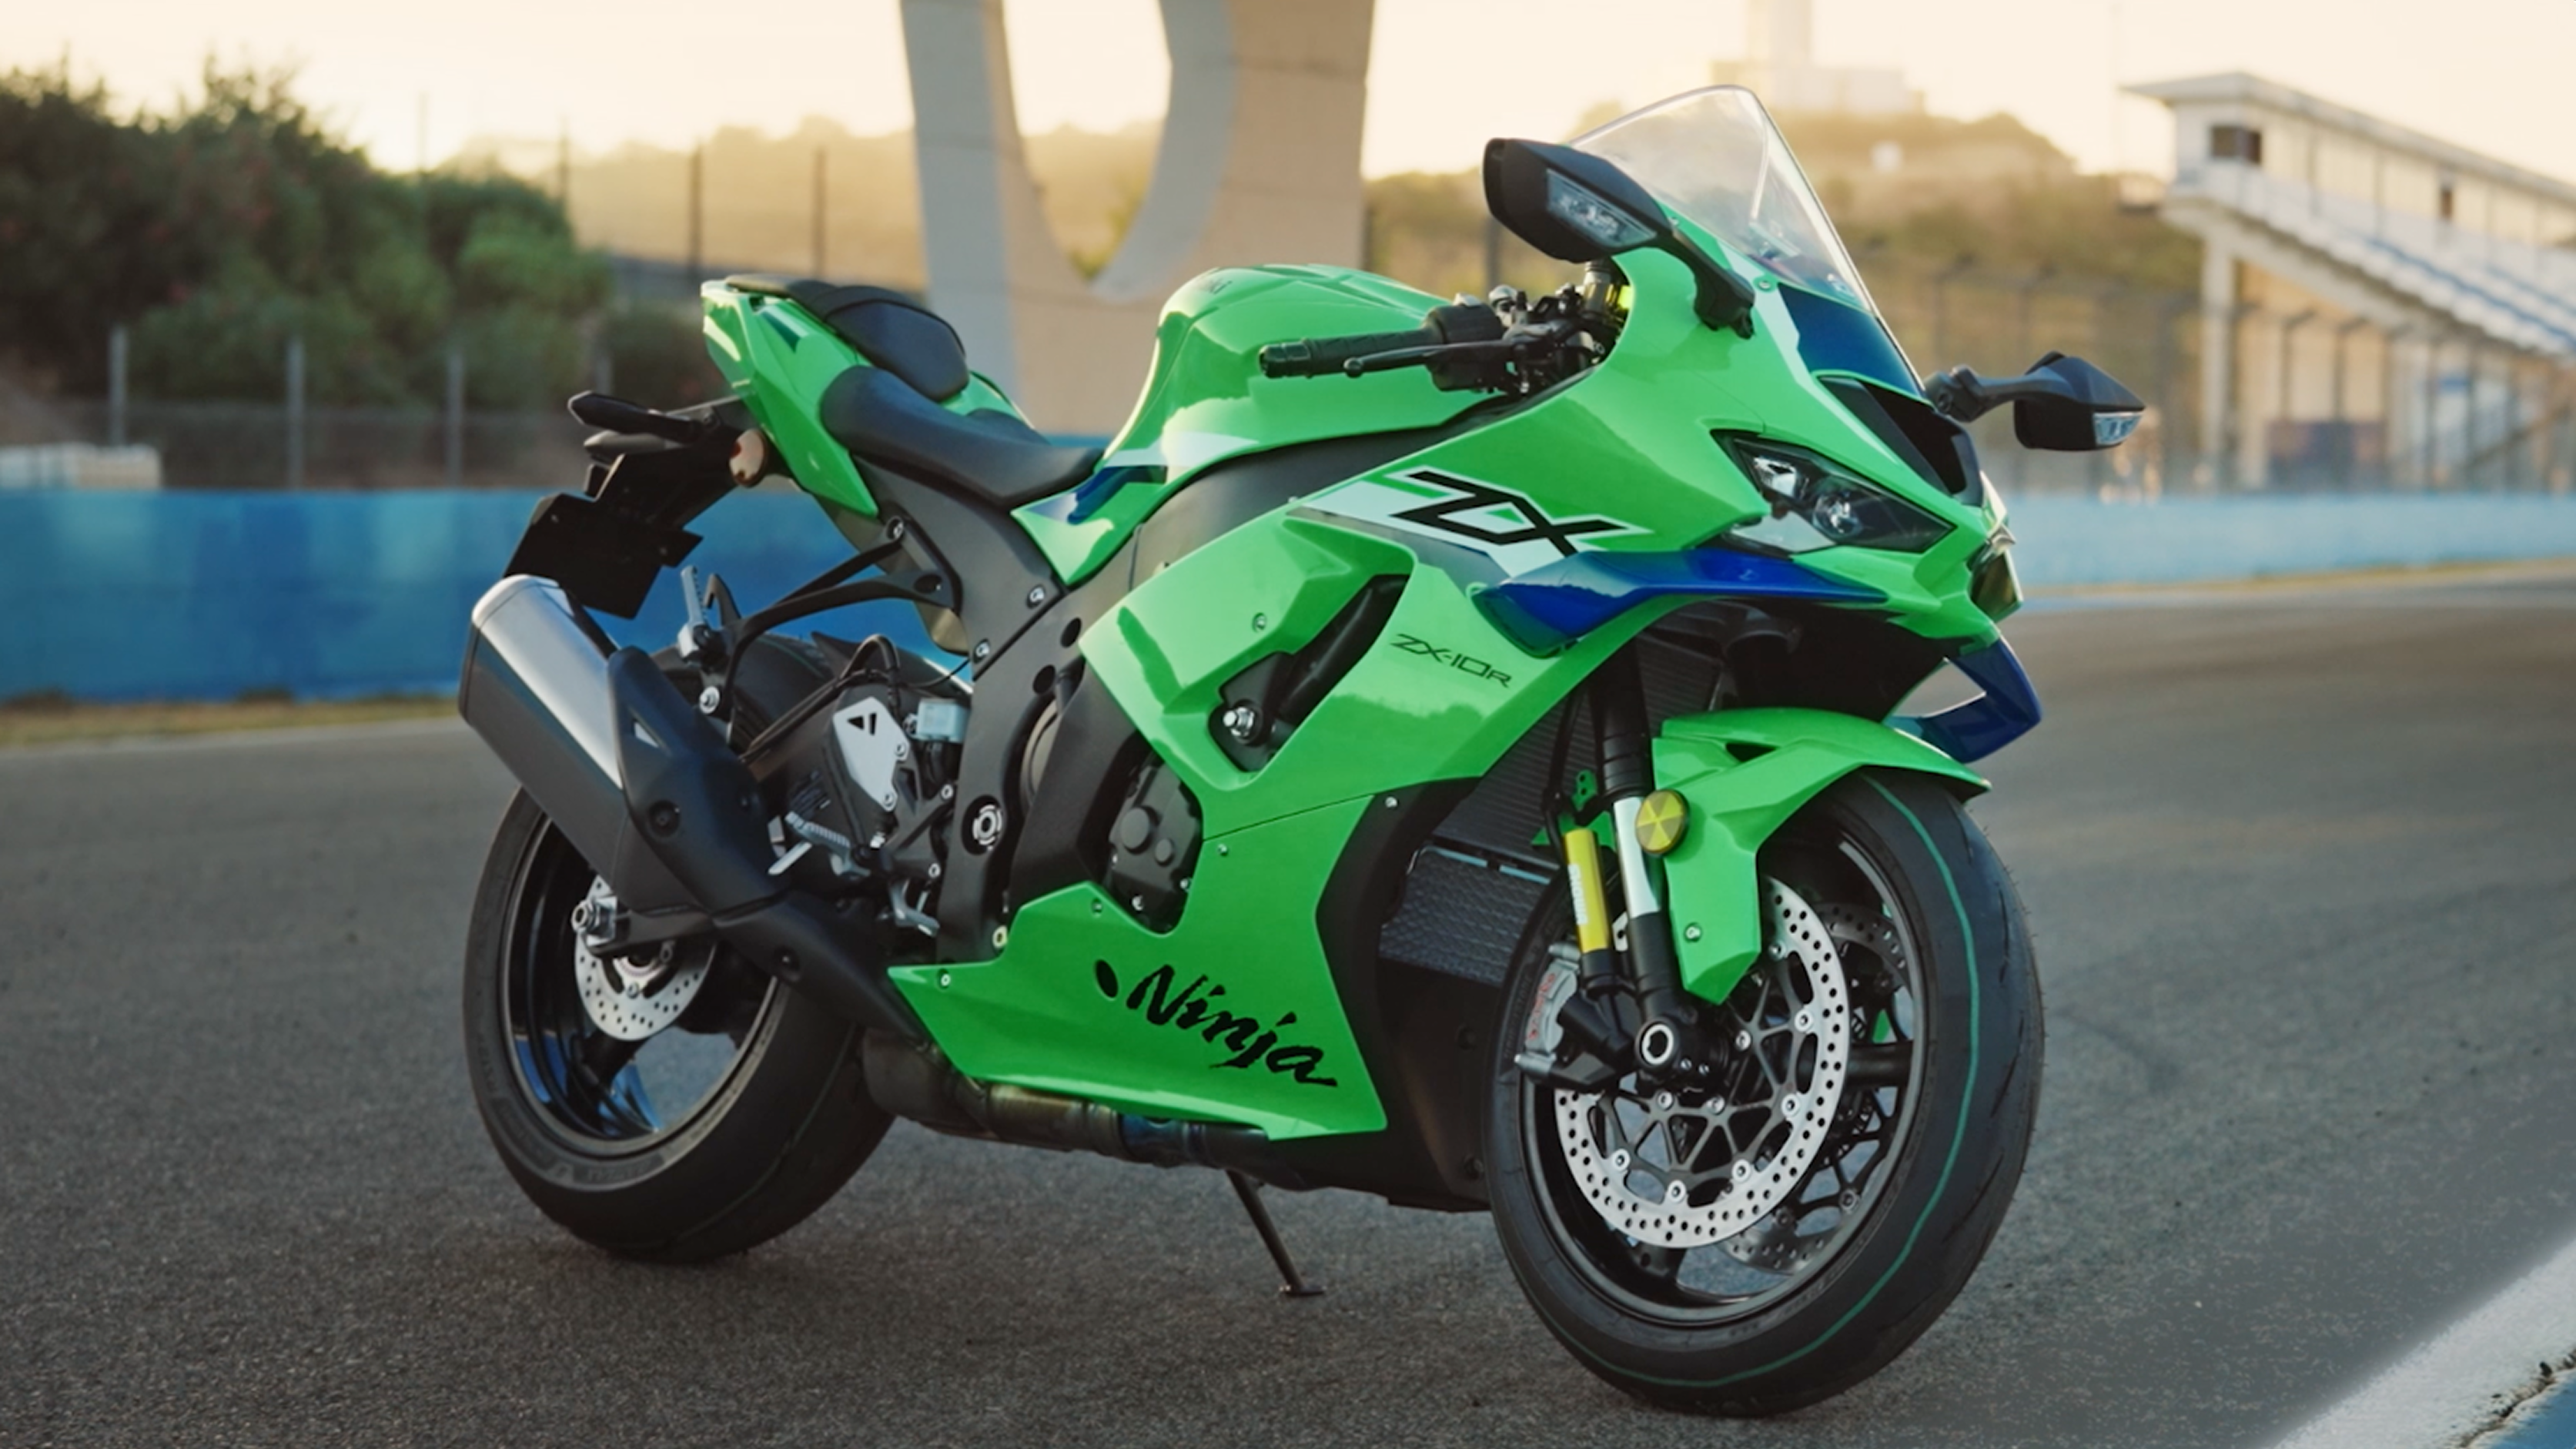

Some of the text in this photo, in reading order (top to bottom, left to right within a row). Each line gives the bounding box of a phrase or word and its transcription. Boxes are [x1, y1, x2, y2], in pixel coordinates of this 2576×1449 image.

[1389, 470, 1628, 557] ZX
[1390, 634, 1512, 688] ZX-10R
[1126, 964, 1338, 1087] Ninja
